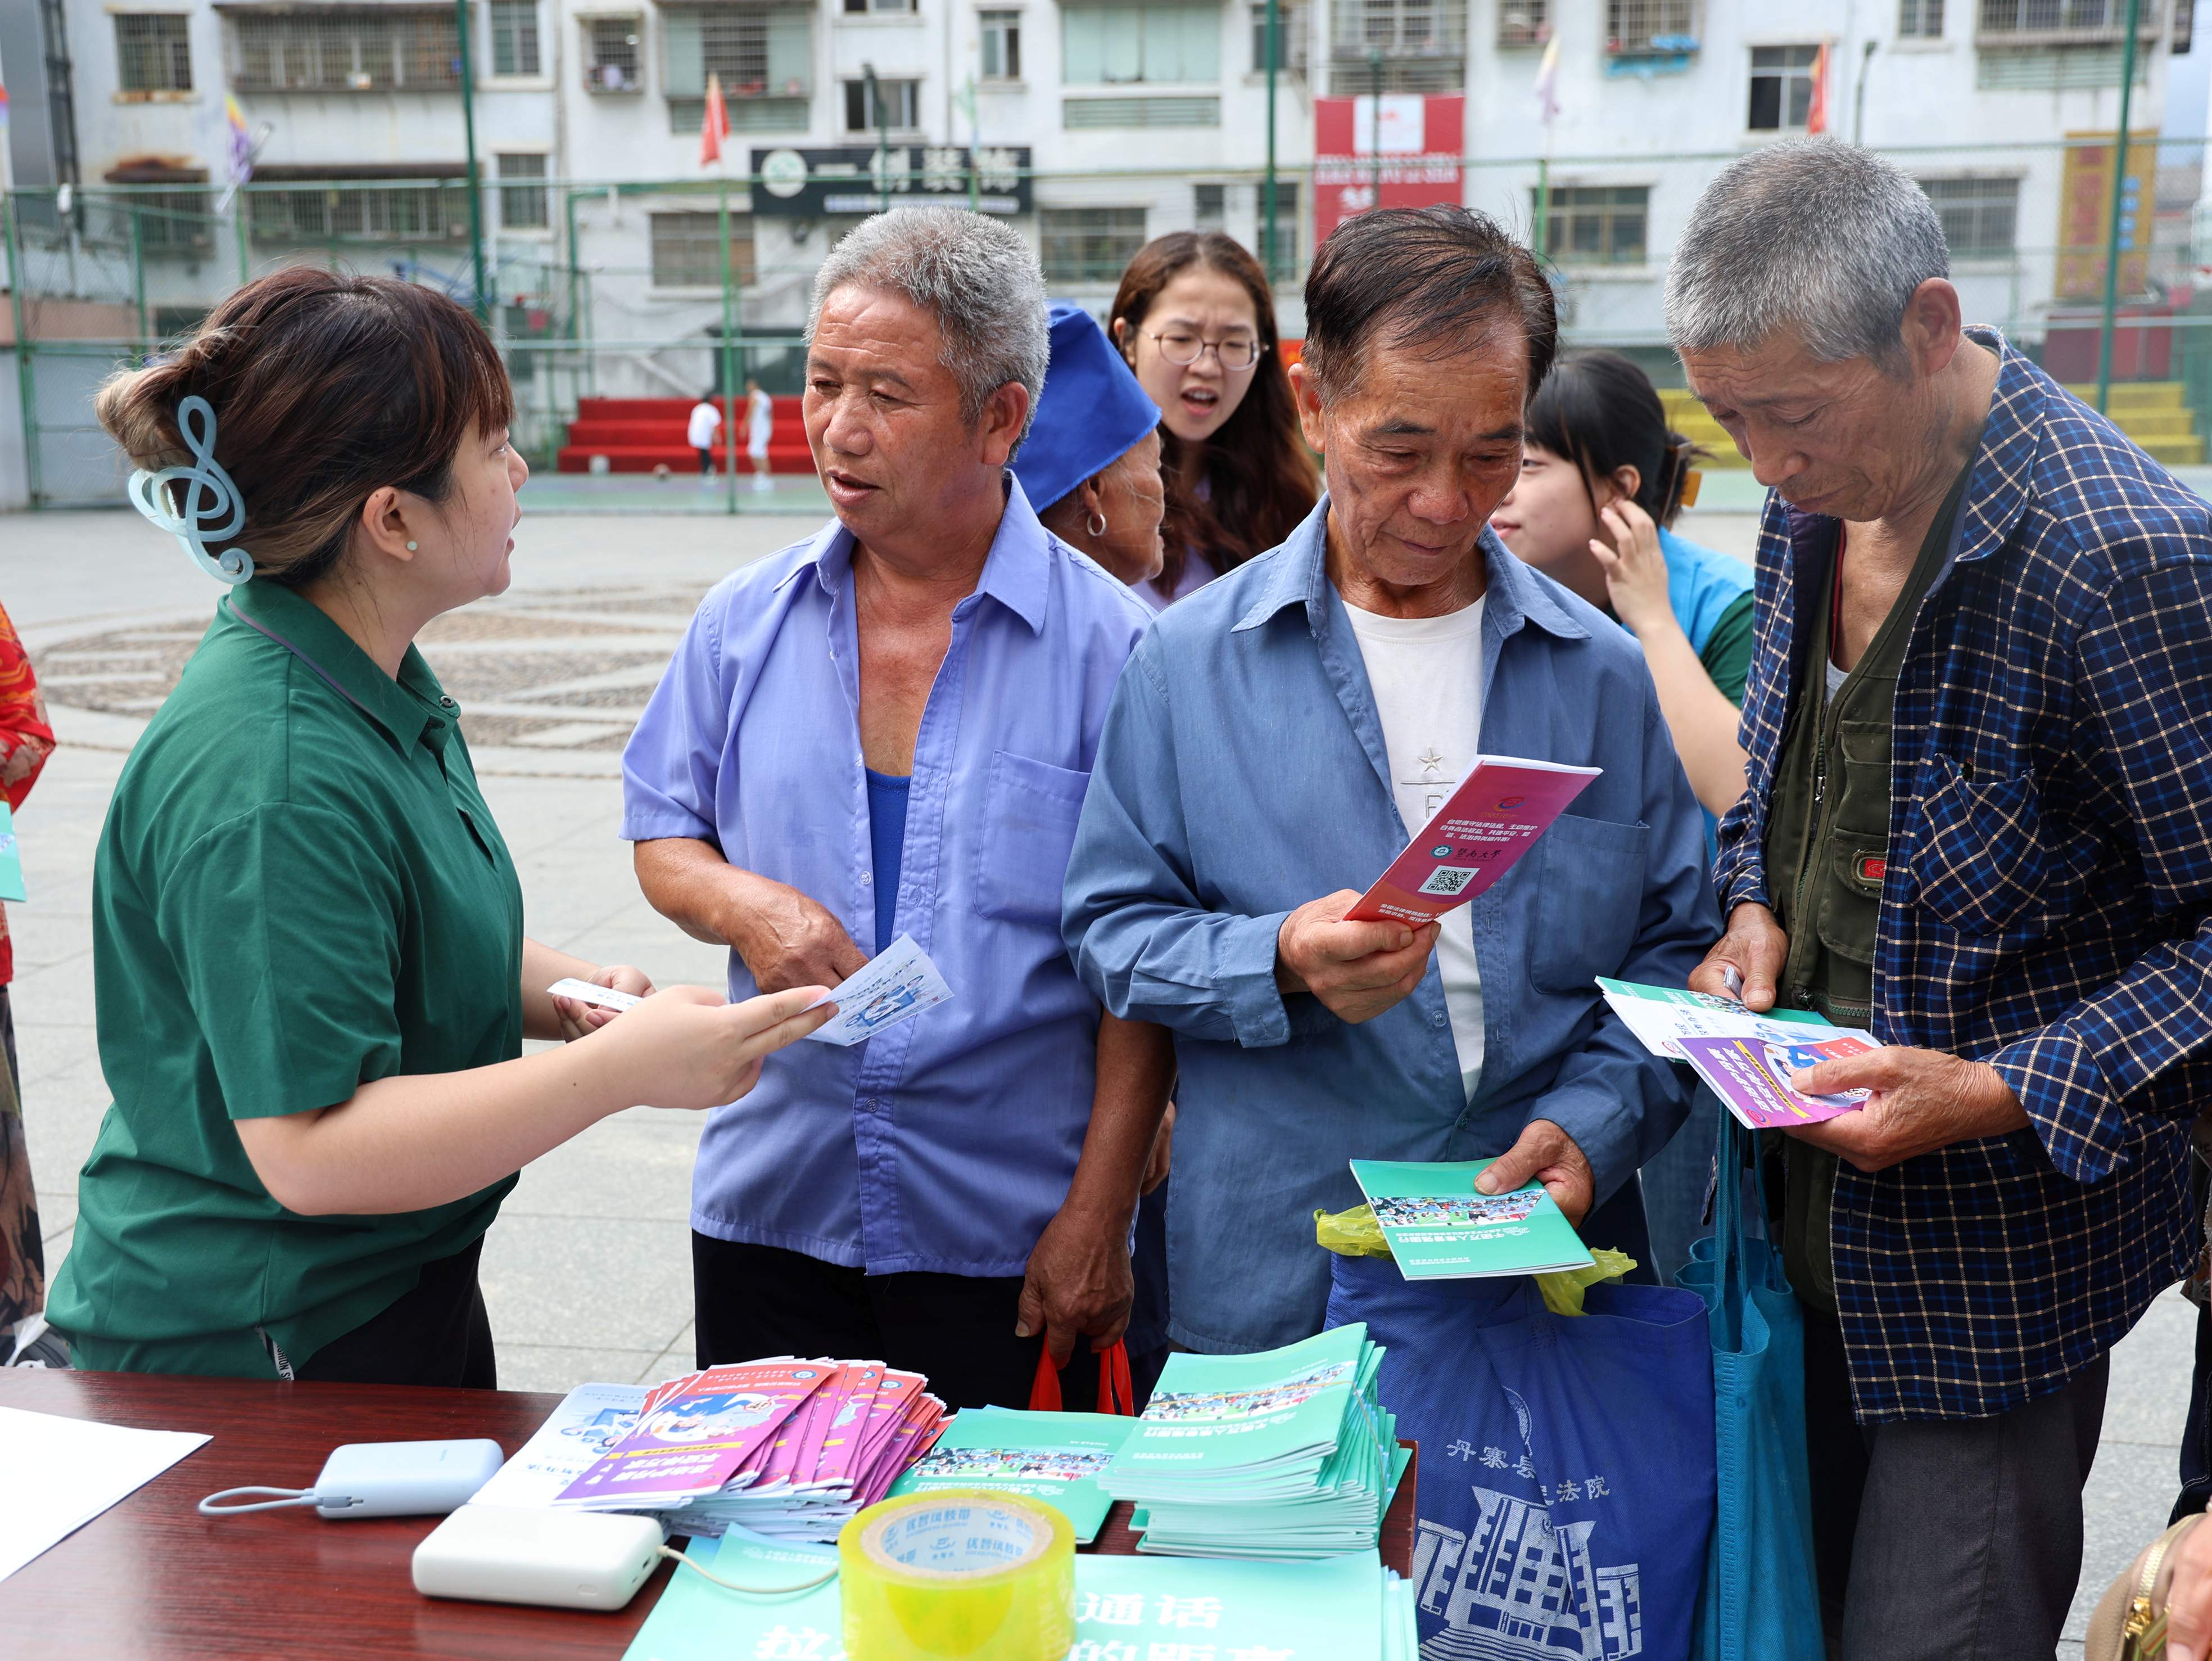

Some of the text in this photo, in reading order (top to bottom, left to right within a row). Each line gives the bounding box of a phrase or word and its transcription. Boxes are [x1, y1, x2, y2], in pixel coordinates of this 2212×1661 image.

[1722, 1047, 1785, 1113] 平安伴万家
[1398, 1232, 1505, 1244] 千团万人推普强国行
[1076, 1592, 1224, 1629] 通话
[753, 1625, 847, 1661] 拉
